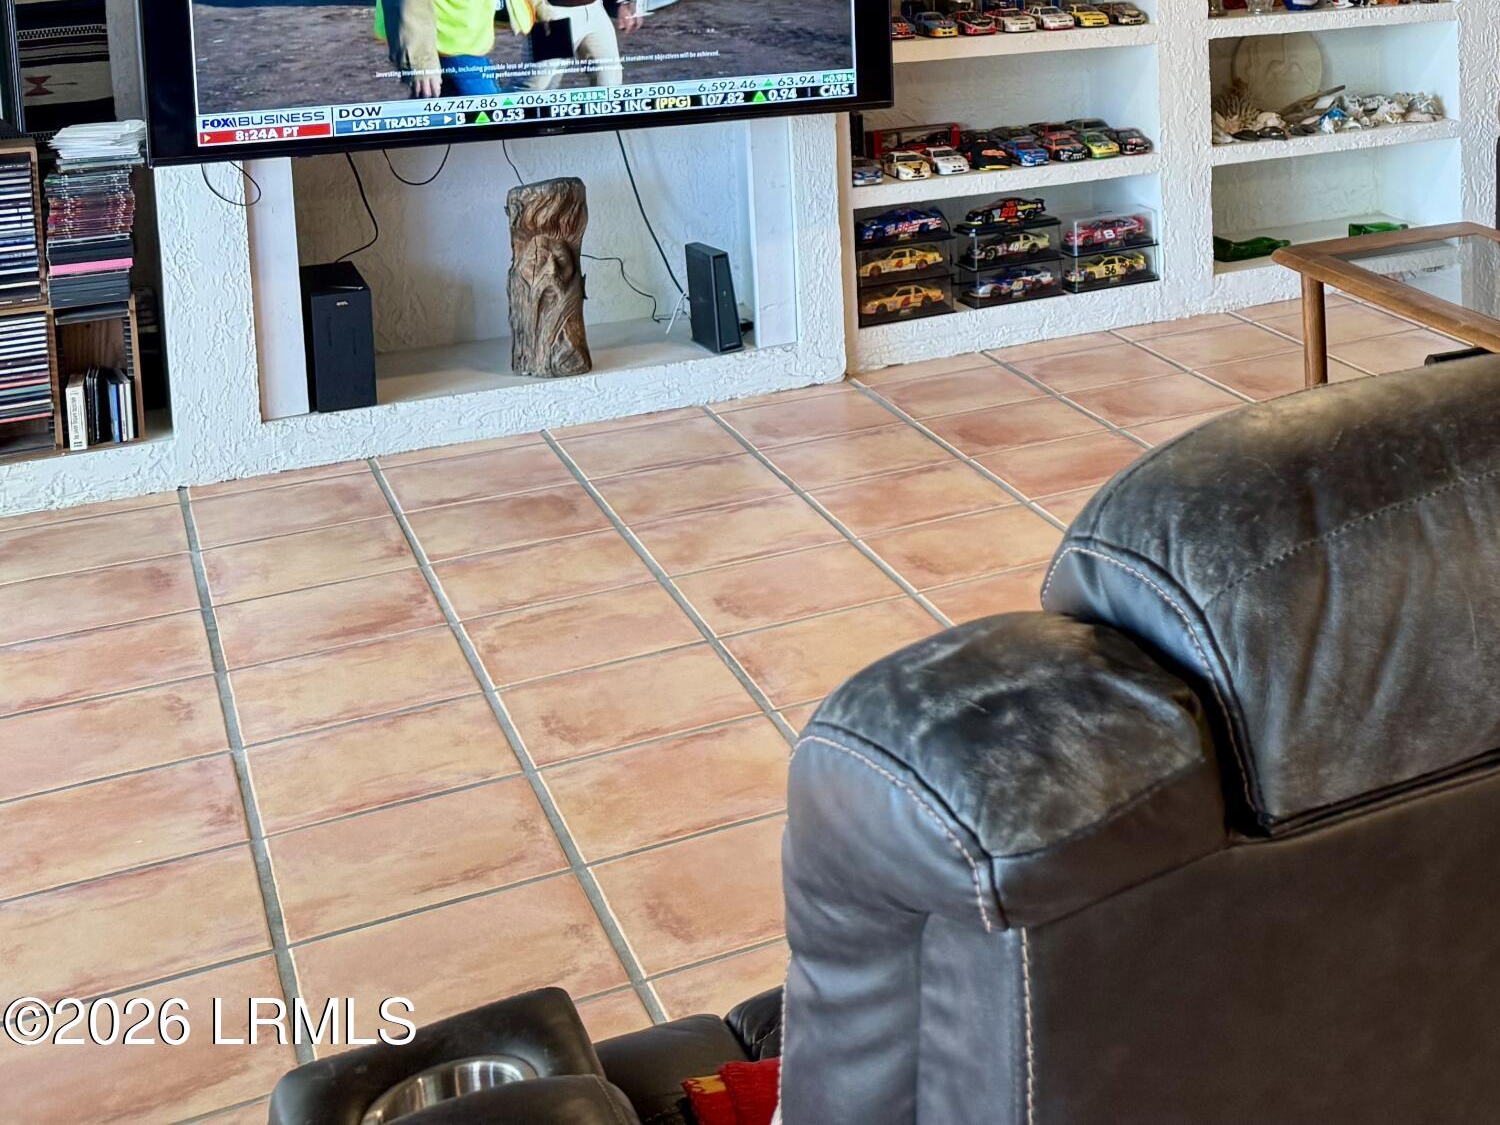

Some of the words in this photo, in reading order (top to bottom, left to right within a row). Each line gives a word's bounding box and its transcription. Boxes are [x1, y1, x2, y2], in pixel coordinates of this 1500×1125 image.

[338, 106, 382, 119] DOW
[516, 93, 567, 106] 406.35
[613, 87, 643, 99] S&P
[648, 85, 675, 96] 500
[777, 75, 816, 87] 63.94
[492, 108, 525, 122] 0.53
[550, 103, 582, 118] PPG
[584, 100, 622, 115] INDS
[624, 98, 652, 112] INC
[656, 94, 692, 110] (PPG)
[700, 91, 745, 106] 107.82
[768, 88, 798, 101] 0.94
[819, 83, 850, 97] CMS
[202, 117, 230, 130] FOX
[238, 111, 325, 127] BUSINESS
[352, 119, 383, 132] LAST
[384, 116, 430, 129] TRADES
[235, 128, 278, 142] 8:24A
[283, 126, 299, 138] PT
[1104, 264, 1117, 275] 36
